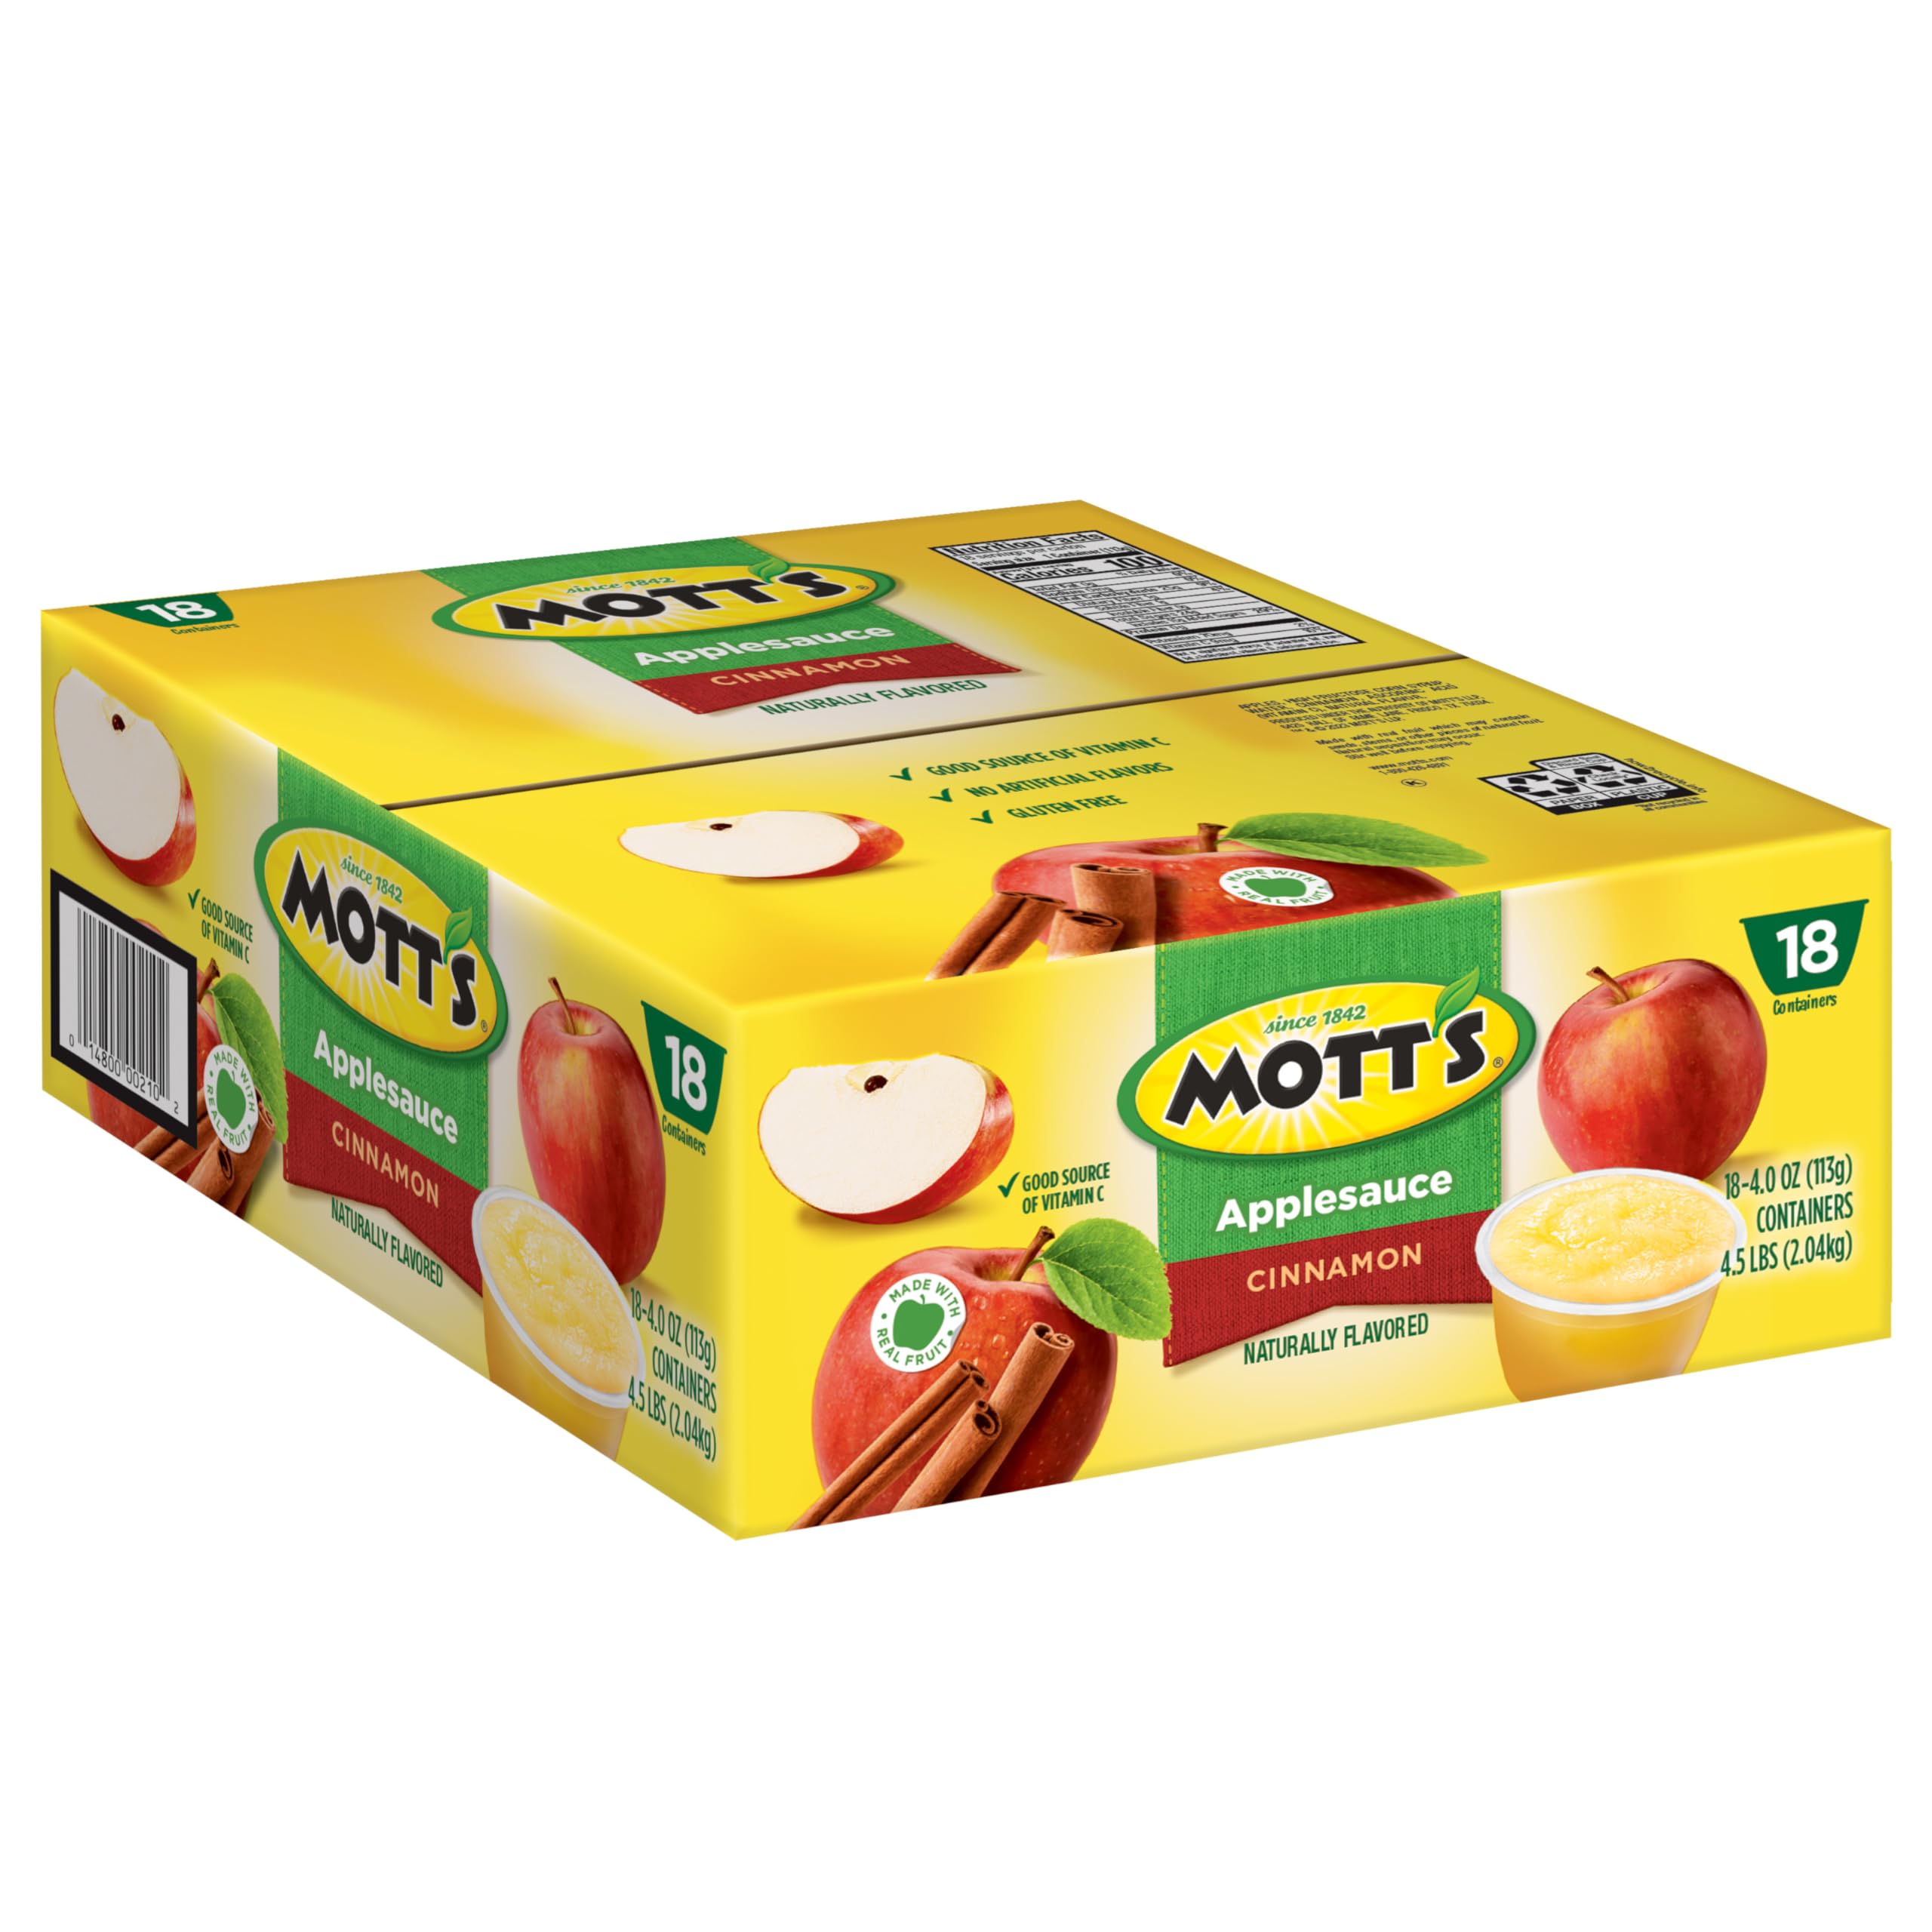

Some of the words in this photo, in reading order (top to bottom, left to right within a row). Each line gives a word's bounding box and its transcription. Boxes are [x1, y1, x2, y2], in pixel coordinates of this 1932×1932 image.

[945, 539, 1039, 555] Nutrition
[1043, 532, 1103, 544] Facts
[974, 558, 1013, 567] Serving
[1051, 549, 1100, 558] Container
[976, 549, 1026, 559] servings
[566, 581, 625, 596] since
[626, 576, 676, 587] 1842
[1001, 565, 1091, 580] Calories
[1104, 555, 1161, 569] 100
[136, 601, 217, 623] 18
[496, 571, 847, 630] MOTT'S
[171, 622, 240, 635] Containers
[632, 626, 896, 666] Applesauce
[709, 654, 910, 687] CINNAMON
[757, 692, 878, 715] NATURALLY
[880, 677, 988, 699] FLAVORED
[1239, 700, 1283, 709] APPLES,
[1315, 689, 1372, 700] FRUCTOSE
[1327, 700, 1377, 709] NATURAL
[1436, 728, 1469, 736] pieces
[1481, 721, 1518, 730] natural
[926, 761, 981, 777] GOOD
[981, 752, 1052, 770] SOURCE
[1049, 749, 1078, 759] OF
[1075, 739, 1152, 756] VITAMIN
[1152, 737, 1171, 746] C
[964, 786, 999, 797] NO
[996, 773, 1096, 793] ARTIFICIAL
[1094, 762, 1174, 780] FLAVORS
[1549, 795, 1598, 805] PAPER
[1610, 784, 1671, 796] PLASTIC
[1006, 801, 1081, 818] GLUTEN
[1073, 795, 1128, 809] FREE
[1570, 801, 1604, 810] BOX
[1636, 792, 1667, 800] CUP
[340, 855, 373, 885] since
[376, 876, 403, 904] 1842
[1226, 869, 1266, 882] MADE
[1272, 869, 1316, 882] WITH
[1238, 891, 1285, 904] REAL
[1290, 890, 1330, 905] FRUIT
[202, 897, 223, 923] GOOD
[225, 909, 254, 943] SOURCE
[282, 848, 476, 1026] MOTT'S
[202, 920, 212, 940] OF
[212, 925, 244, 961] VITAMIN
[245, 946, 250, 964] C
[1776, 919, 1838, 979] 18
[1263, 1013, 1318, 1035] since
[1323, 1004, 1367, 1025] 1842
[1774, 994, 1837, 1015] Containers
[69, 1033, 75, 1048] 0
[88, 1043, 121, 1077] 14800
[126, 1067, 160, 1102] 00210
[174, 1101, 179, 1115] 2
[214, 1050, 239, 1072] MADE
[240, 1069, 256, 1112] WITH
[314, 1029, 458, 1144] Applesauce
[665, 1034, 708, 1111] 18
[1165, 1011, 1485, 1126] MOTT'S
[207, 1084, 222, 1131] REAL
[223, 1128, 248, 1147] FRUIT
[661, 1115, 706, 1156] Containers
[331, 1121, 439, 1208] CINNAMON
[1023, 1171, 1057, 1192] GOOD
[1062, 1162, 1110, 1185] SOURCE
[1724, 1165, 1776, 1199] 18-4.0
[1781, 1161, 1801, 1190] OZ
[1806, 1153, 1853, 1190] (113g)
[1023, 1195, 1038, 1214] OF
[1041, 1186, 1094, 1211] VITAMIN
[1097, 1186, 1104, 1201] C
[1216, 1170, 1453, 1233] Applesauce
[1757, 1192, 1854, 1233] CONTAINERS
[331, 1196, 389, 1253] NATURALLY
[391, 1235, 443, 1288] FLAVORED
[1721, 1247, 1746, 1276] 4.5
[1750, 1241, 1778, 1272] LBS
[1783, 1229, 1853, 1271] (2.04kg)
[1247, 1243, 1422, 1292] CINNAMON
[889, 1278, 931, 1303] MADE
[935, 1282, 961, 1318] WITH
[630, 1287, 666, 1335] 18-4.0
[668, 1315, 682, 1346] OZ
[685, 1323, 717, 1373] (113g)
[877, 1328, 900, 1363] REAL
[905, 1342, 948, 1365] FRUIT
[1244, 1327, 1337, 1364] NATURALLY
[1344, 1312, 1429, 1348] FLAVORED
[652, 1345, 718, 1414] CONTAINERS
[628, 1375, 645, 1415] 4.5
[648, 1392, 666, 1427] LBS
[669, 1403, 717, 1462] (2.04kg)
